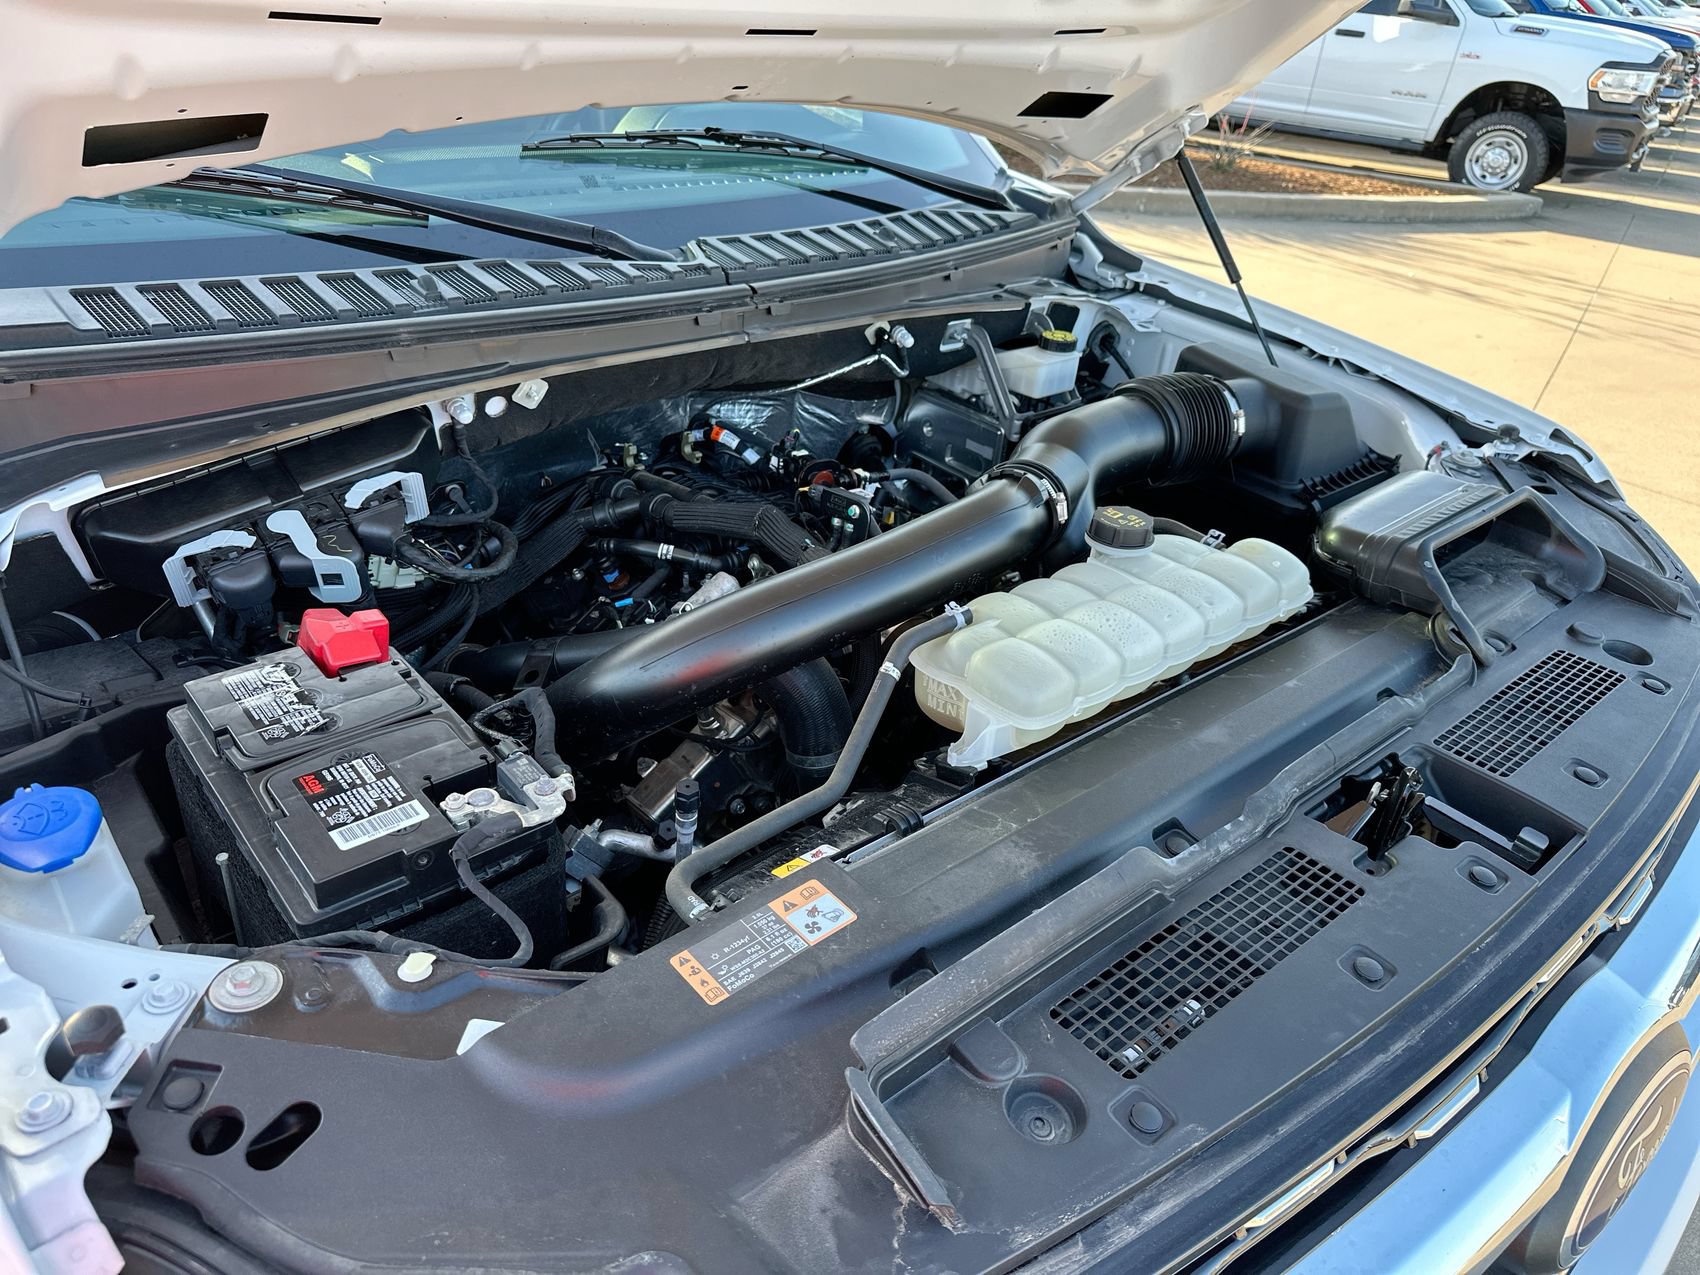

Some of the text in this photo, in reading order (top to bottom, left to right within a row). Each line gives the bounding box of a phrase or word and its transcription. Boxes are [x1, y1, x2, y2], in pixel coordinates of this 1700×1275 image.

[928, 677, 958, 701] MAX
[928, 693, 958, 718] MIN
[302, 774, 325, 794] AGM
[723, 935, 751, 953] R-1234yf
[746, 944, 762, 955] PAG
[723, 974, 737, 986] SAE
[727, 973, 755, 992] FoMoCo
